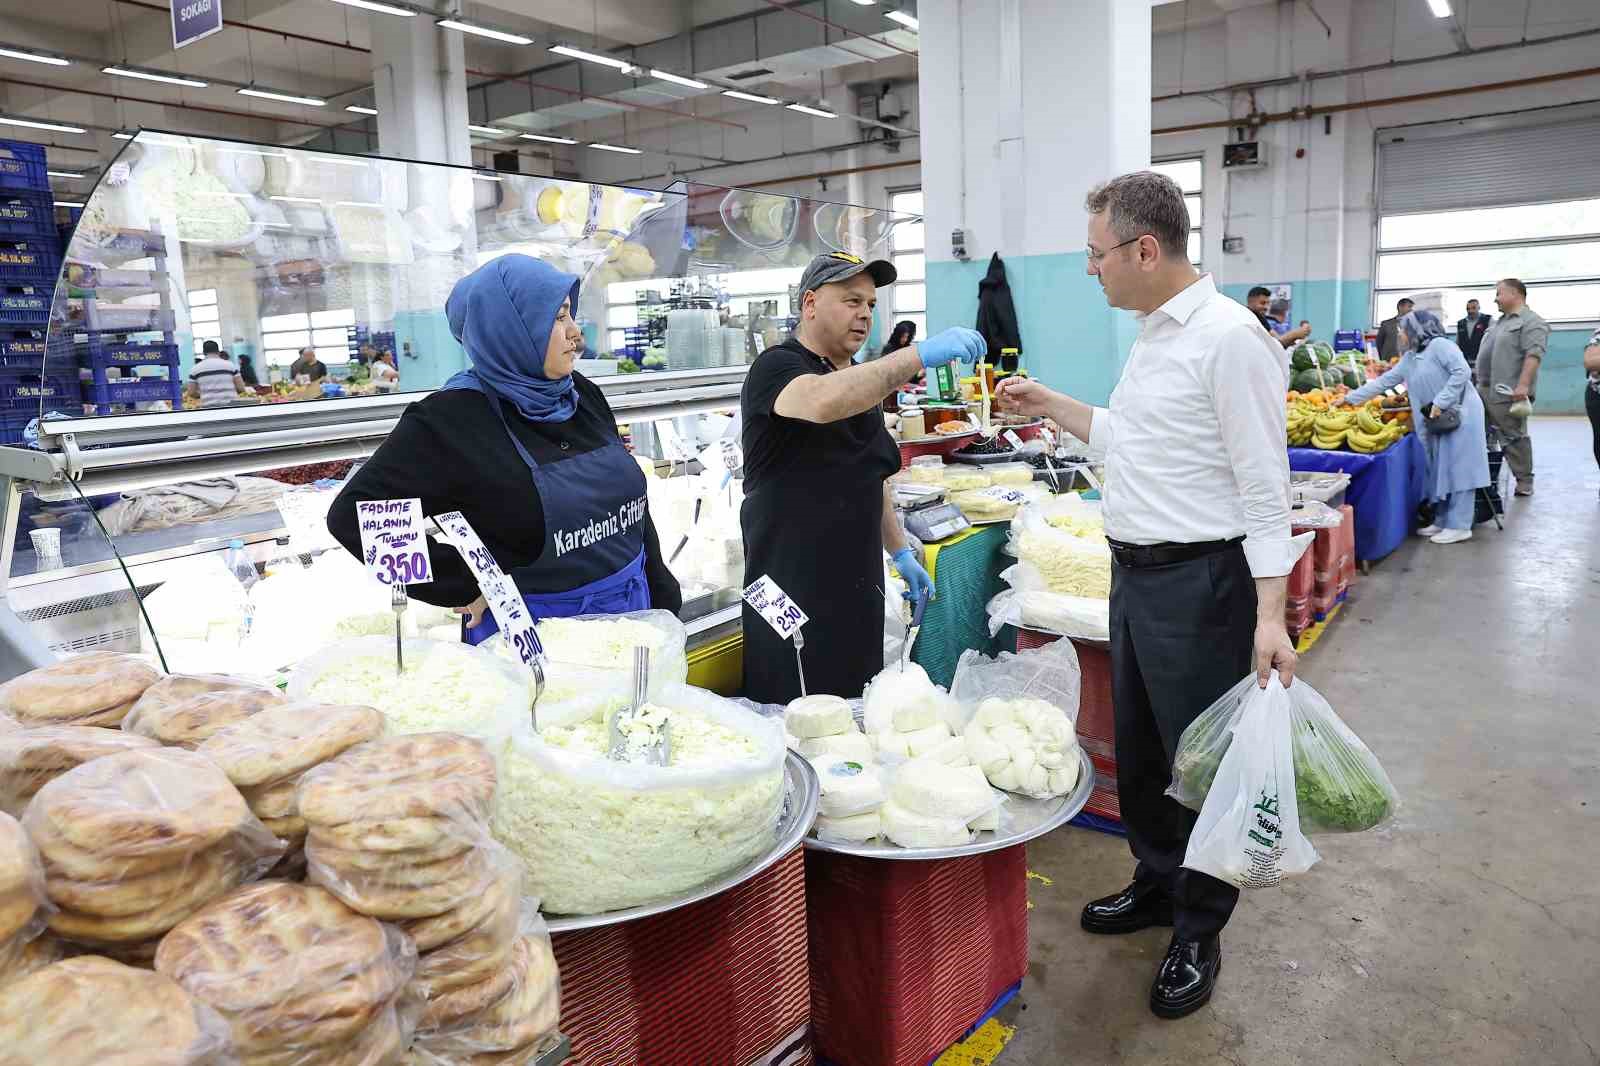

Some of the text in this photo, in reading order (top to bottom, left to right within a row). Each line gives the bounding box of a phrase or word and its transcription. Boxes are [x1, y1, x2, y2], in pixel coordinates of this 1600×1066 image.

[359, 501, 412, 515] FADİME
[362, 515, 412, 531] HALANIN
[553, 511, 619, 557] Karadeniz
[776, 605, 802, 632] 250
